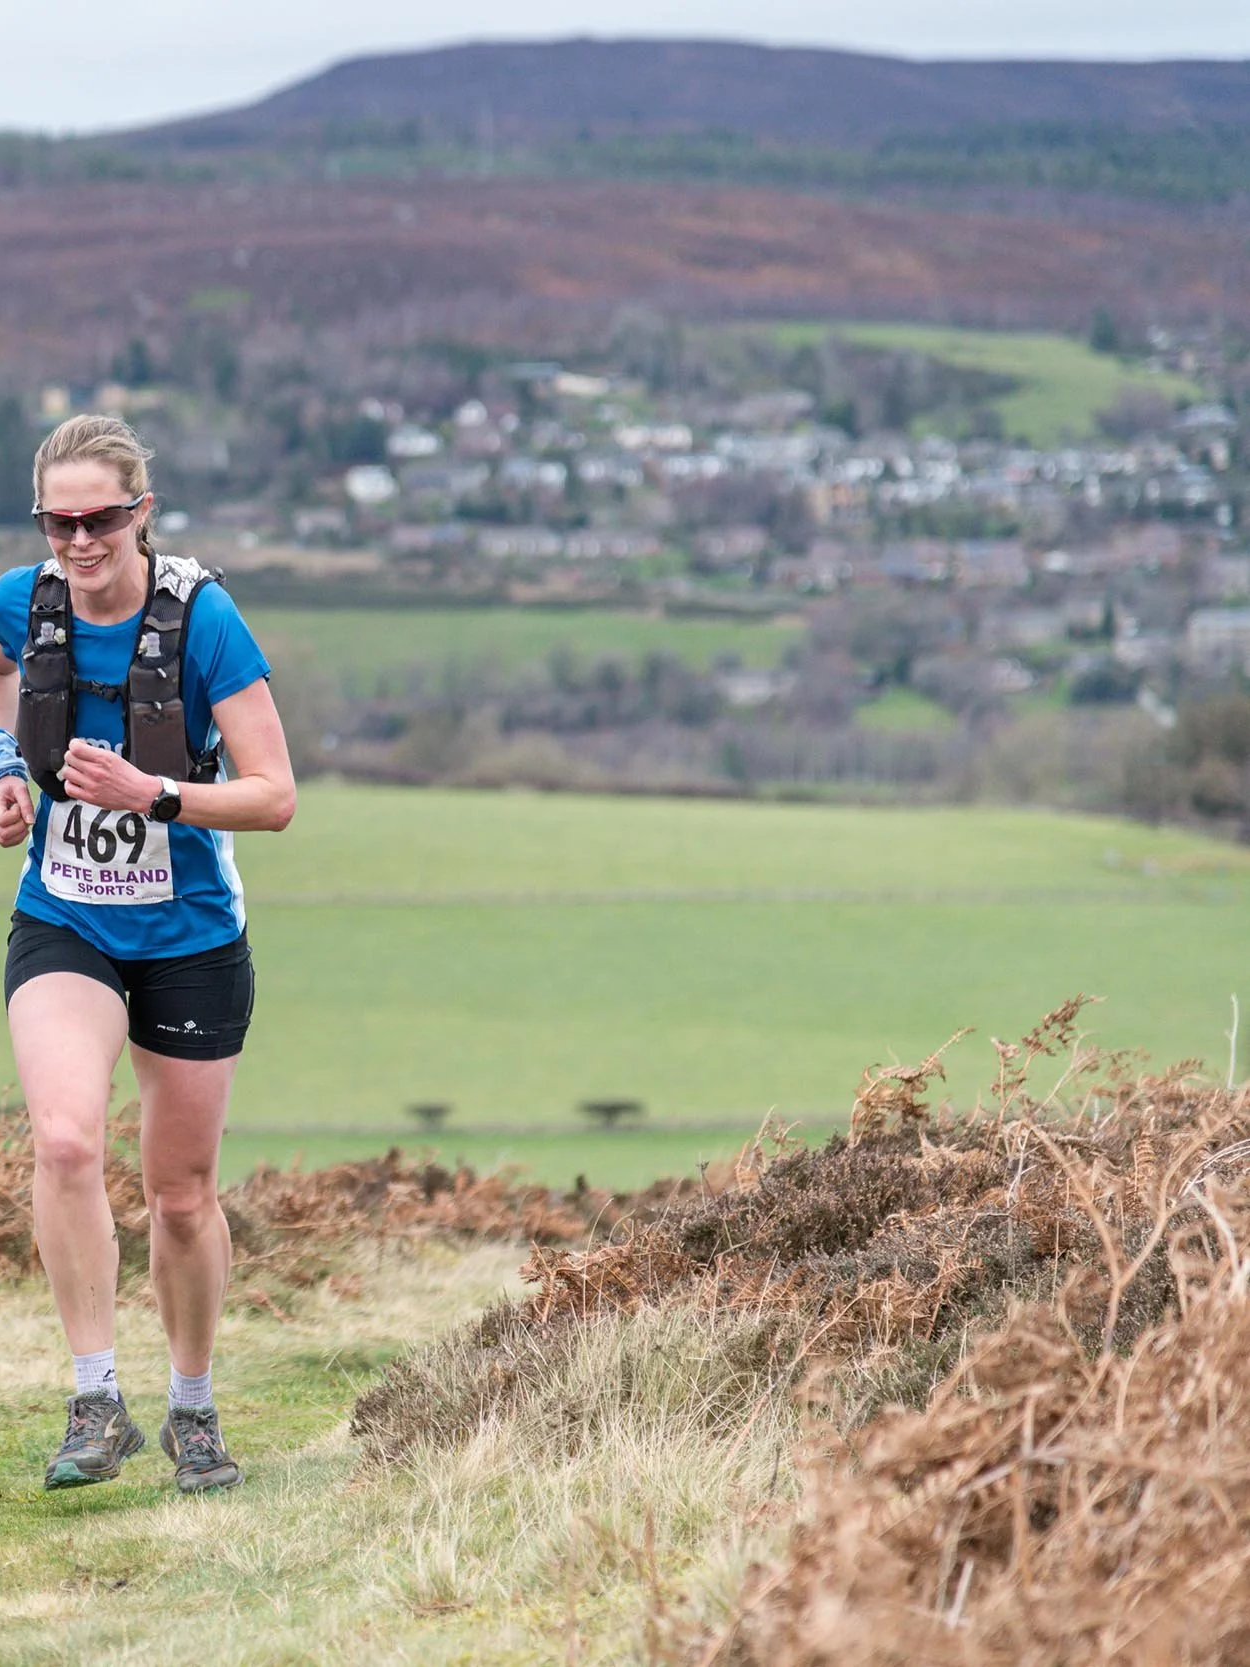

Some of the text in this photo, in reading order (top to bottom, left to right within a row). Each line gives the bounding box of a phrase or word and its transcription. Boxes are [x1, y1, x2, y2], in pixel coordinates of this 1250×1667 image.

[63, 804, 147, 864] 469
[50, 861, 168, 883] PETE BLAND
[78, 883, 135, 896] SPORTS
